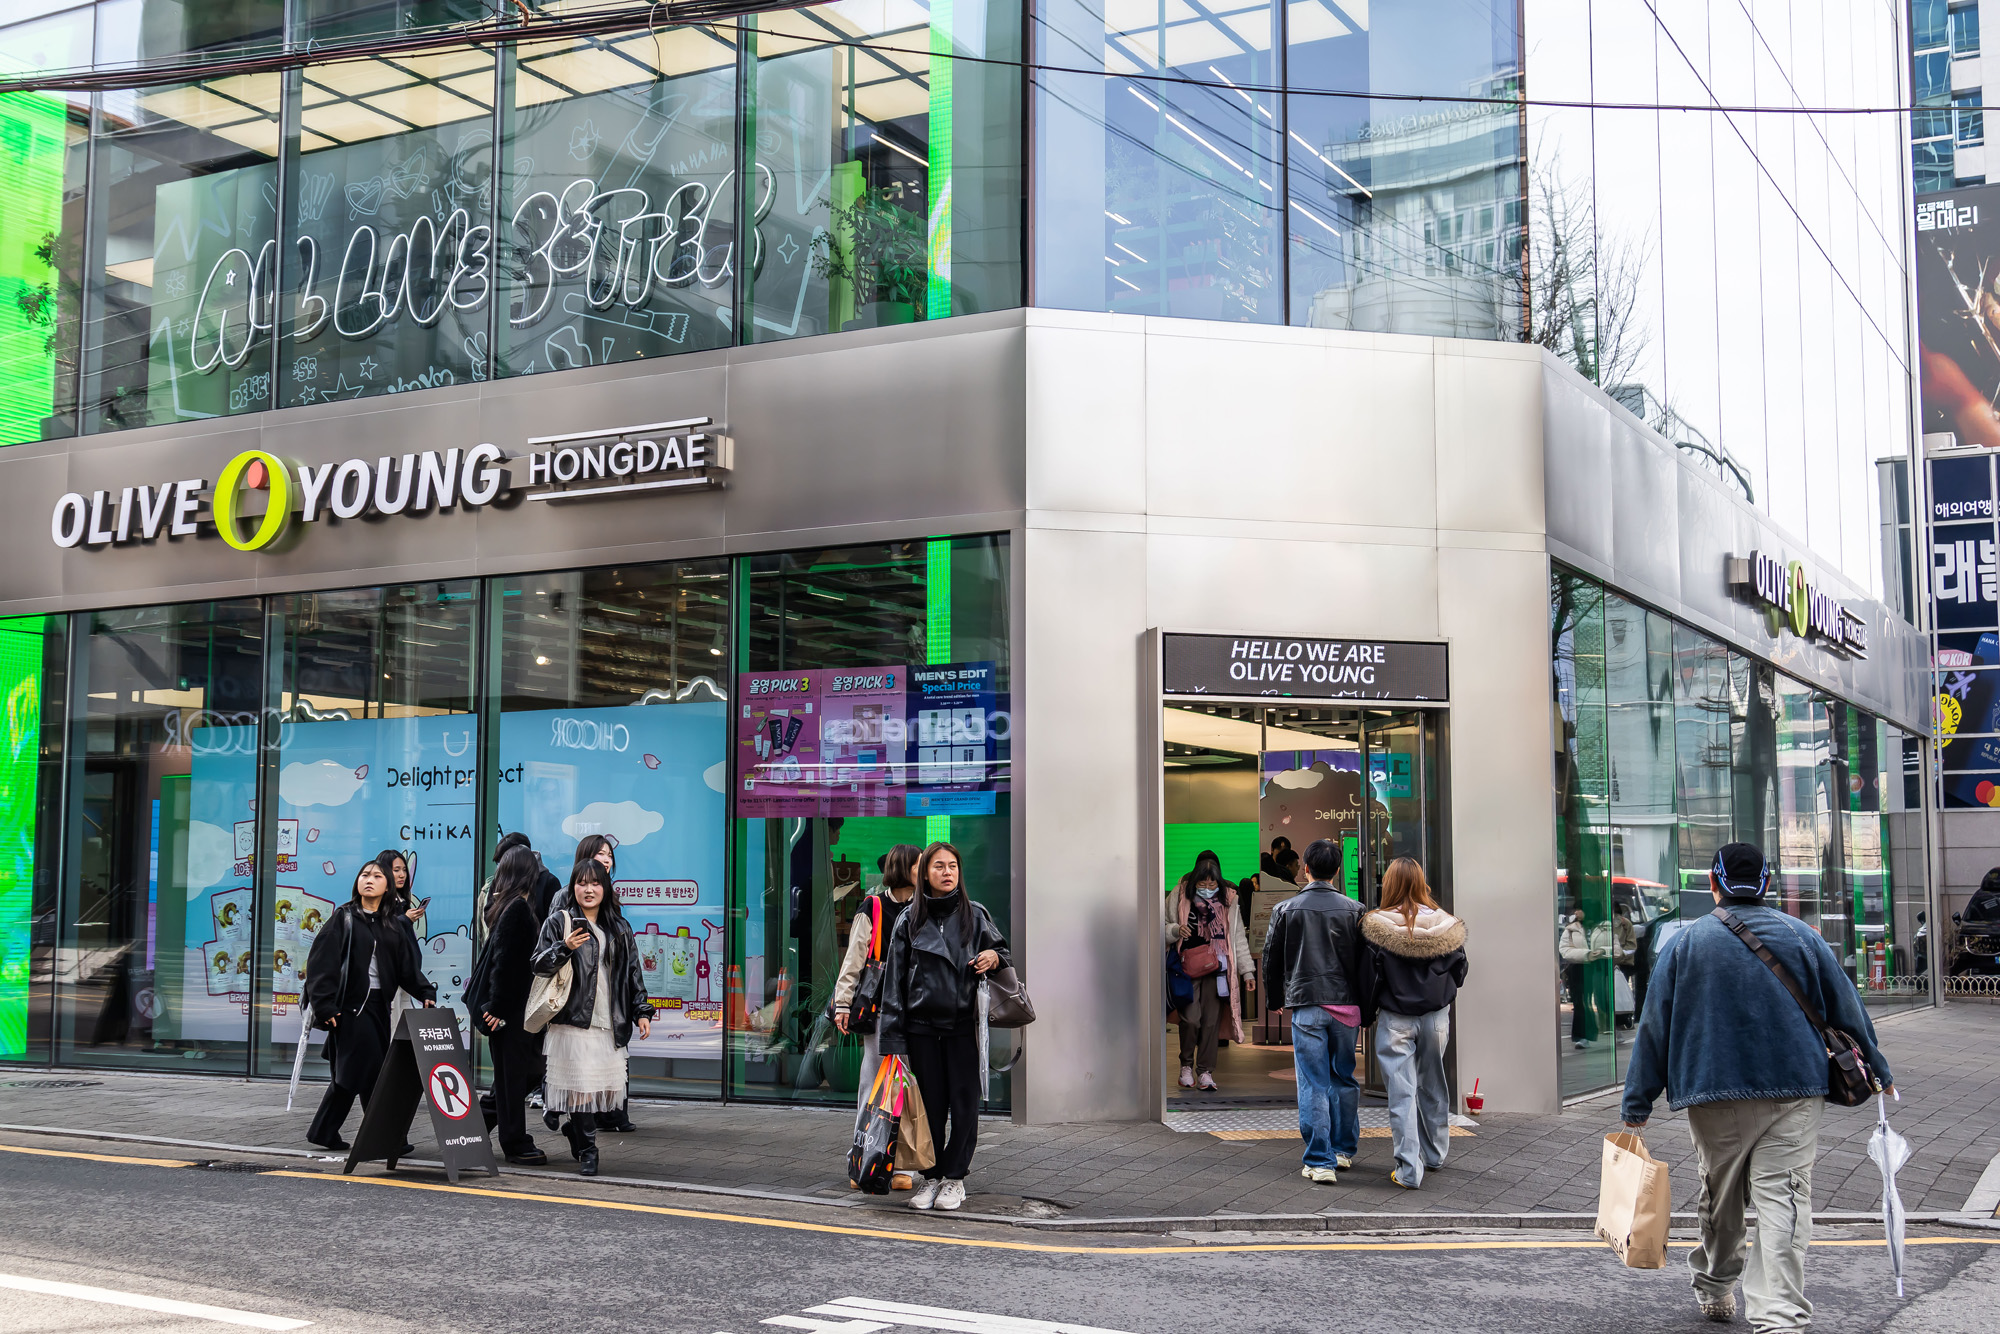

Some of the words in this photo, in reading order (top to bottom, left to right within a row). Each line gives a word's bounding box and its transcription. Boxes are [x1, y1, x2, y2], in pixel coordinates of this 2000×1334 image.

[1917, 199, 1954, 213] 프로젝트
[529, 433, 706, 484] HONGDAE
[52, 479, 206, 548] OLIVE
[297, 443, 507, 522] YOUNG
[1935, 500, 1992, 518] 해외여행
[1930, 540, 1998, 604] 래블
[1755, 550, 1792, 613] OLIVE
[1807, 586, 1844, 644] YOUNG
[1844, 616, 1868, 650] HONGDAE
[1231, 640, 1303, 661] HELLO
[1306, 643, 1340, 662] WE
[1344, 645, 1386, 664] ARE
[1949, 652, 1972, 666] KOR
[914, 670, 957, 681] MEN'S
[959, 669, 988, 679] EDIT
[1229, 662, 1295, 682] OLIVE
[1298, 664, 1376, 684] YOUNG
[800, 677, 811, 692] 3
[885, 674, 896, 689] 3
[922, 681, 955, 695] Special
[957, 680, 981, 692] Price
[387, 765, 451, 791] Delight
[1315, 808, 1355, 823] Delight
[646, 886, 661, 898] 단독
[664, 886, 695, 898] 특별한정
[418, 1027, 453, 1041] 주차금지
[423, 1044, 433, 1052] NO
[433, 1043, 455, 1052] PARKING
[445, 1137, 460, 1146] OLIVE
[466, 1135, 483, 1144] YOUNG
